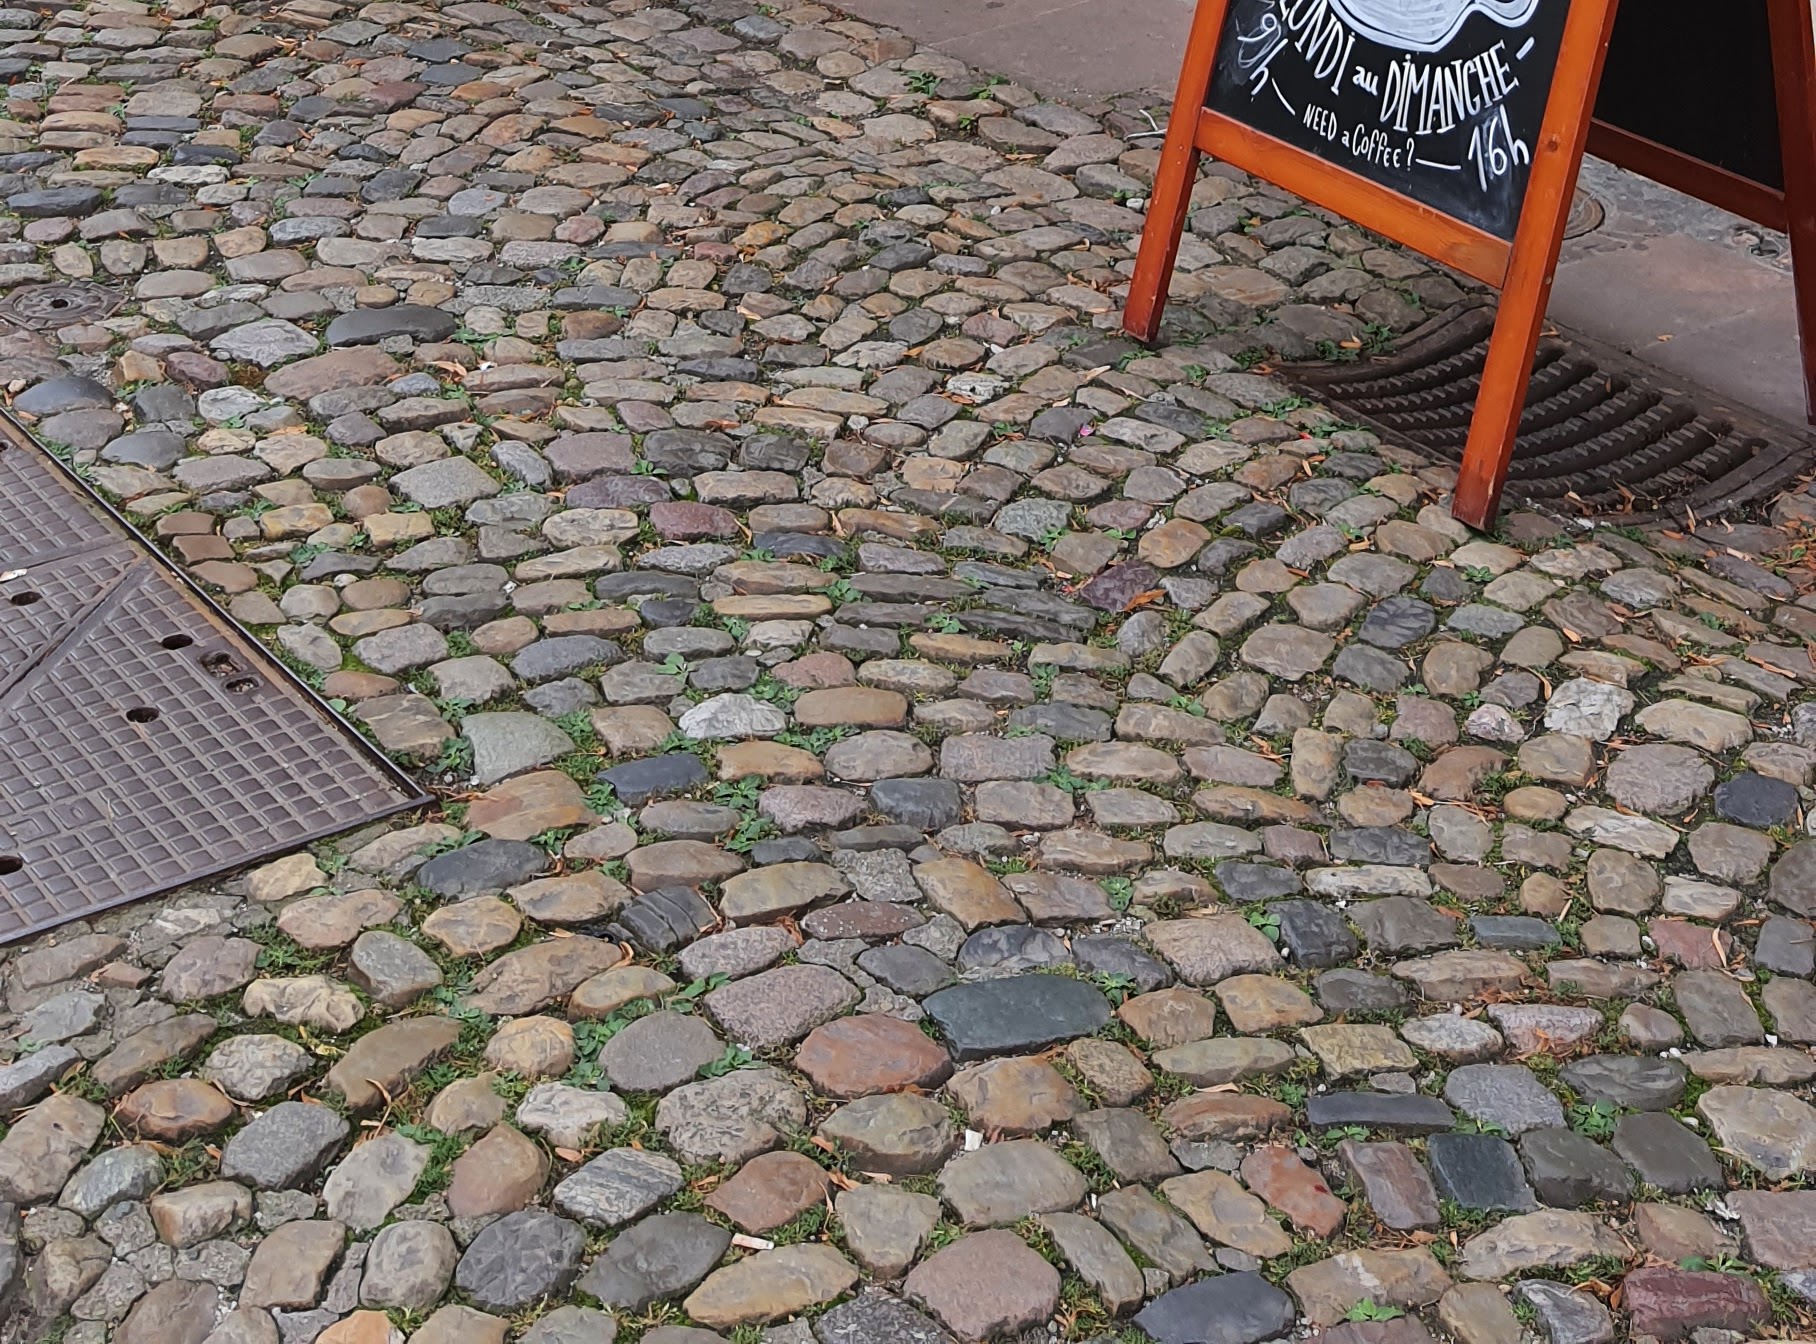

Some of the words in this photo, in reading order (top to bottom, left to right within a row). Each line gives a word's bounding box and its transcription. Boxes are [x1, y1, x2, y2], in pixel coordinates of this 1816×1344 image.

[1302, 103, 1337, 141] NEED
[1341, 130, 1350, 148] a
[1352, 65, 1378, 96] au
[1379, 38, 1521, 136] DIMANCHE
[1468, 104, 1531, 192] 16h
